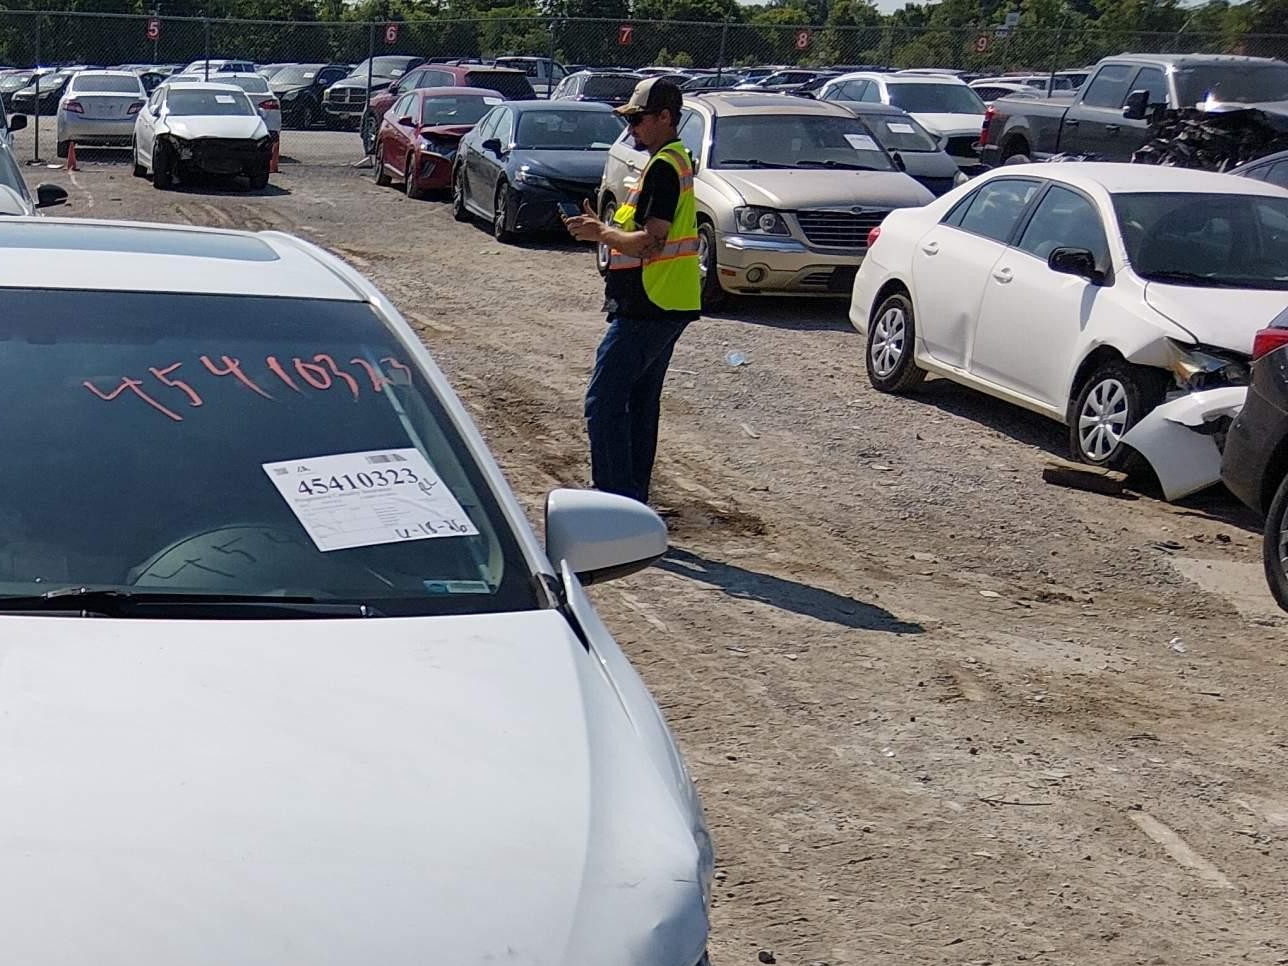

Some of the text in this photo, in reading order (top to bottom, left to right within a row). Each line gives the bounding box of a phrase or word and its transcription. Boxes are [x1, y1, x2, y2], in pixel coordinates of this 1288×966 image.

[148, 22, 158, 36] 5
[386, 27, 397, 41] 6
[621, 28, 632, 42] 7
[797, 32, 808, 47] 8
[977, 37, 987, 52] 9
[298, 467, 418, 495] 45410323
